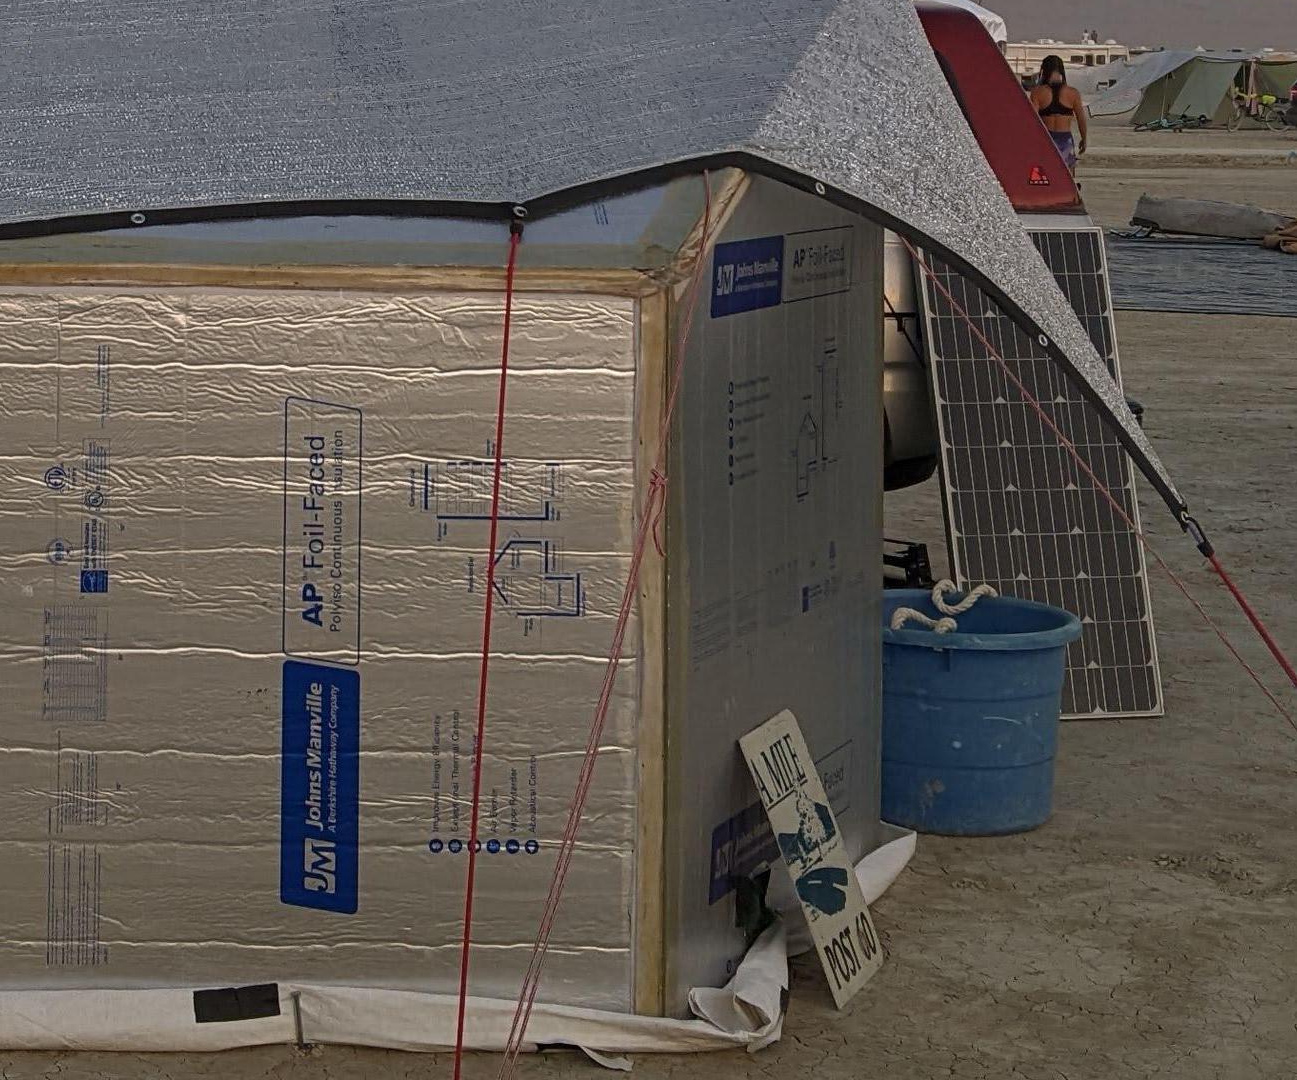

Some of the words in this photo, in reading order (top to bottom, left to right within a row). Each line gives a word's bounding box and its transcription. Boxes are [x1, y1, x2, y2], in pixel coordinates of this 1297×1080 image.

[793, 248, 806, 269] AP
[303, 436, 325, 569] Foil-Faced
[330, 501, 343, 579] Continuous
[302, 583, 323, 627] AP
[329, 584, 344, 632] Polyiso
[306, 682, 323, 768] Manville
[329, 684, 340, 729] Company
[451, 710, 461, 741] Control
[328, 730, 339, 778] Hathaway
[431, 759, 441, 789] Energy
[528, 754, 537, 786] Control
[760, 733, 807, 799] MILE
[305, 770, 323, 831] Johns
[328, 780, 337, 823] Berkshire
[750, 758, 774, 804] A
[824, 926, 862, 990] POST
[856, 911, 878, 961] 60
